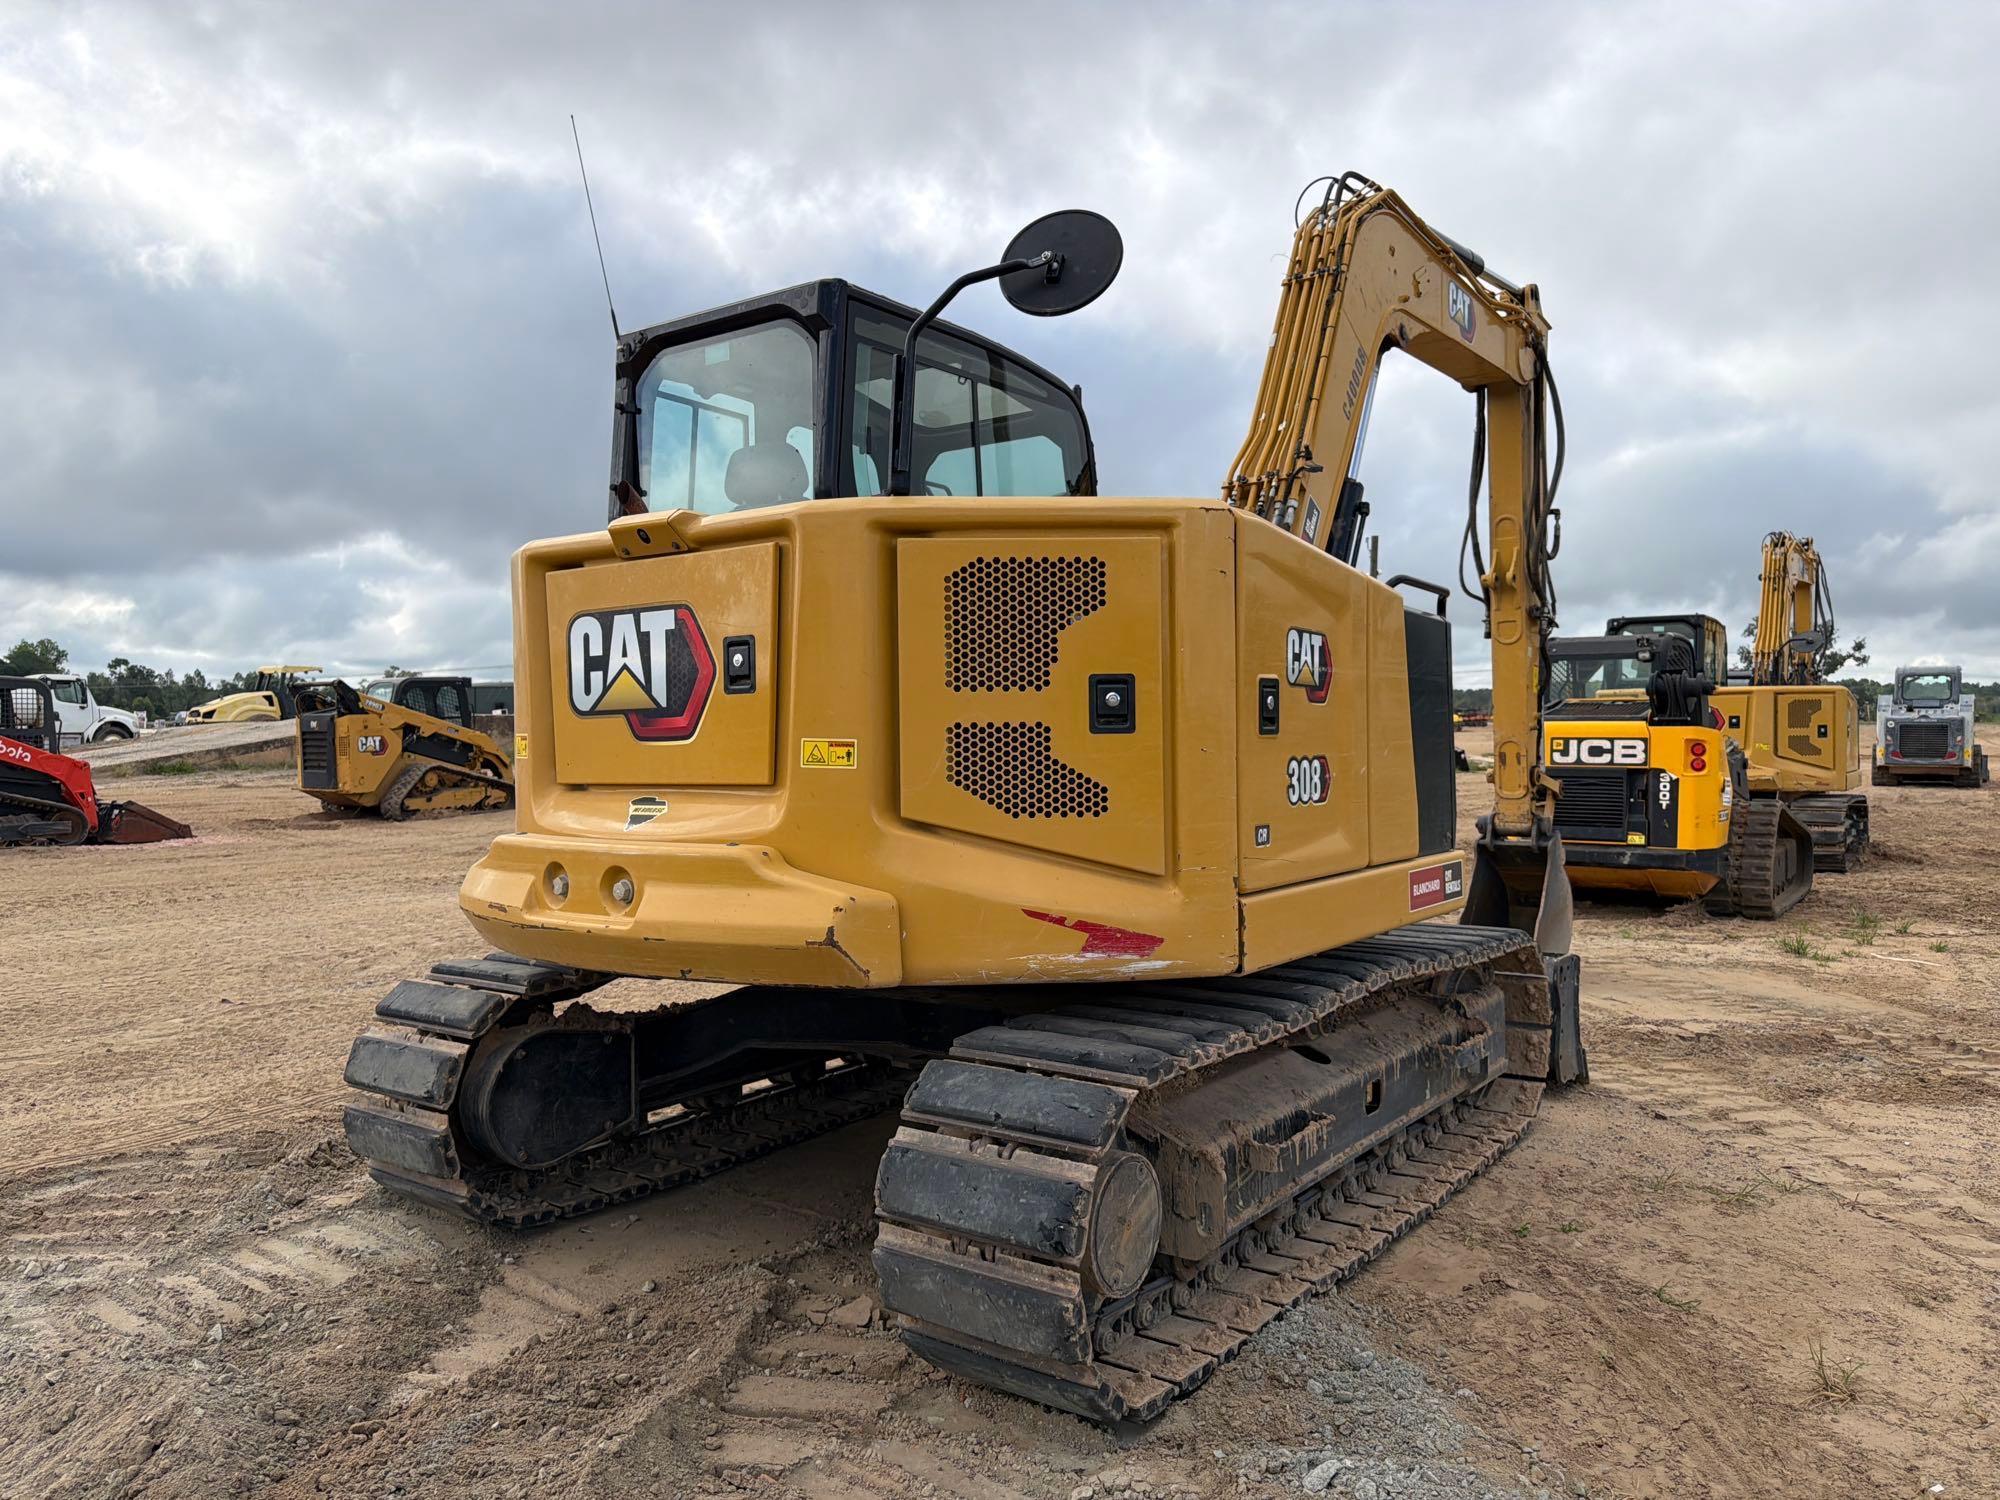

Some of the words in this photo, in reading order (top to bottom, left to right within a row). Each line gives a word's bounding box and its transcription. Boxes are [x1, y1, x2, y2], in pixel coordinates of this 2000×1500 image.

[1449, 281, 1471, 330] CAT
[570, 609, 675, 711] CAT
[1287, 629, 1322, 686] CAT
[358, 736, 381, 752] CAT
[1552, 739, 1646, 764] JCB
[1288, 759, 1321, 803] 308
[1659, 772, 1670, 810] 300T
[1258, 828, 1268, 843] CR
